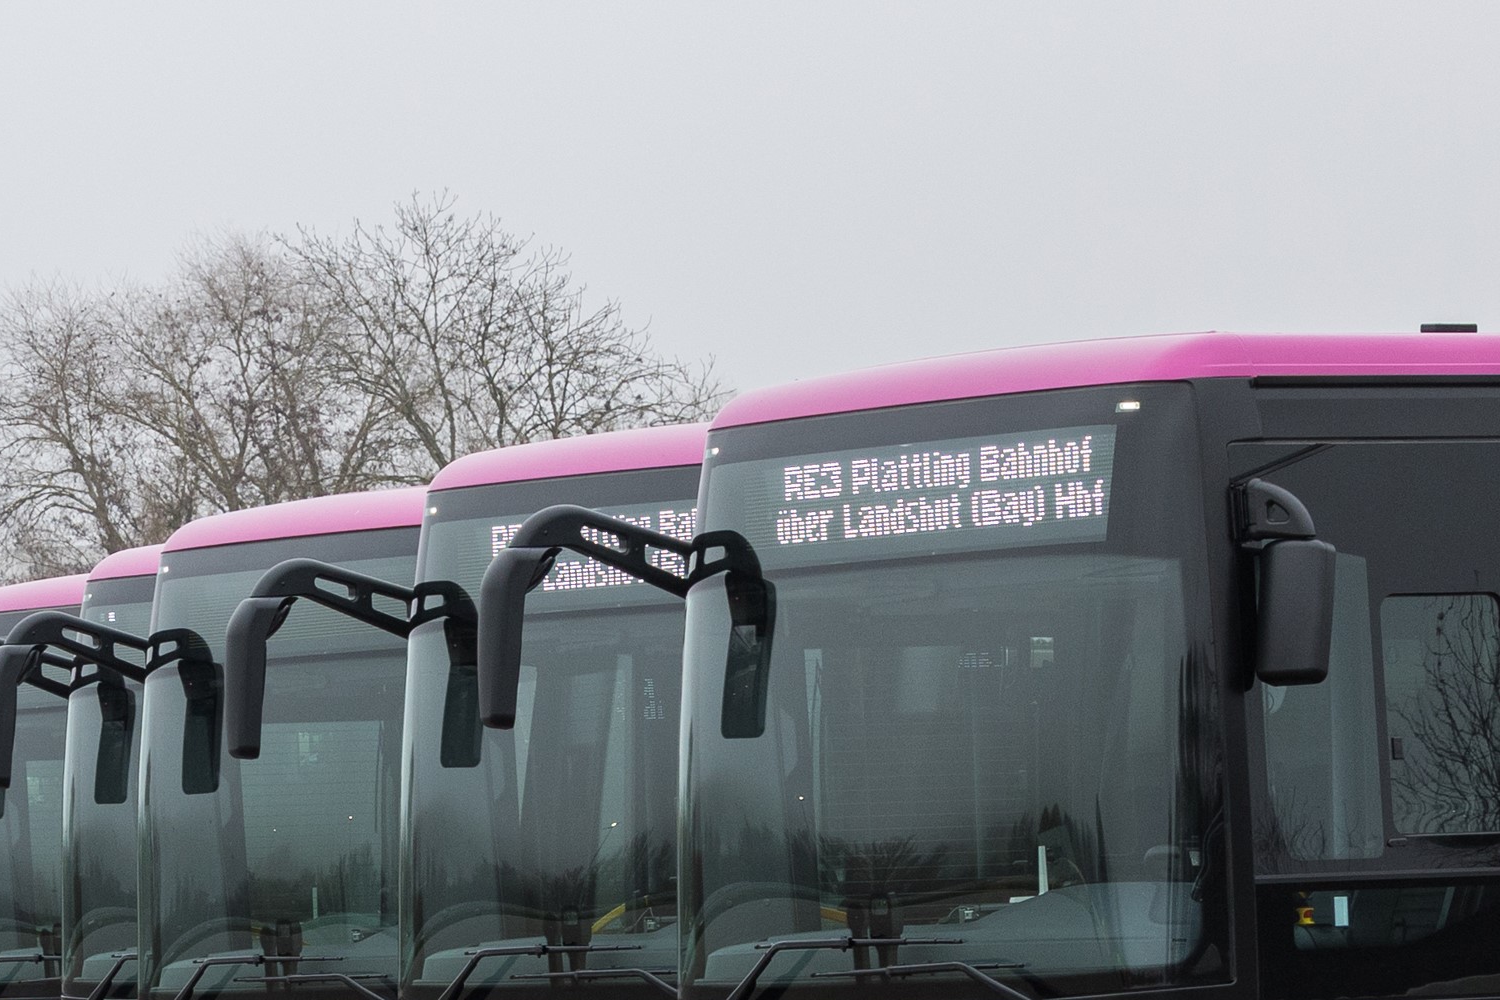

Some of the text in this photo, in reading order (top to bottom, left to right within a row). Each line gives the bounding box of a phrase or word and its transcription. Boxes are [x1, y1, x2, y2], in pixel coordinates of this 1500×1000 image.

[784, 435, 1093, 501] RE3 Plattling Bahnhof
[777, 479, 1105, 545] über Landshut (Bay) Hbf
